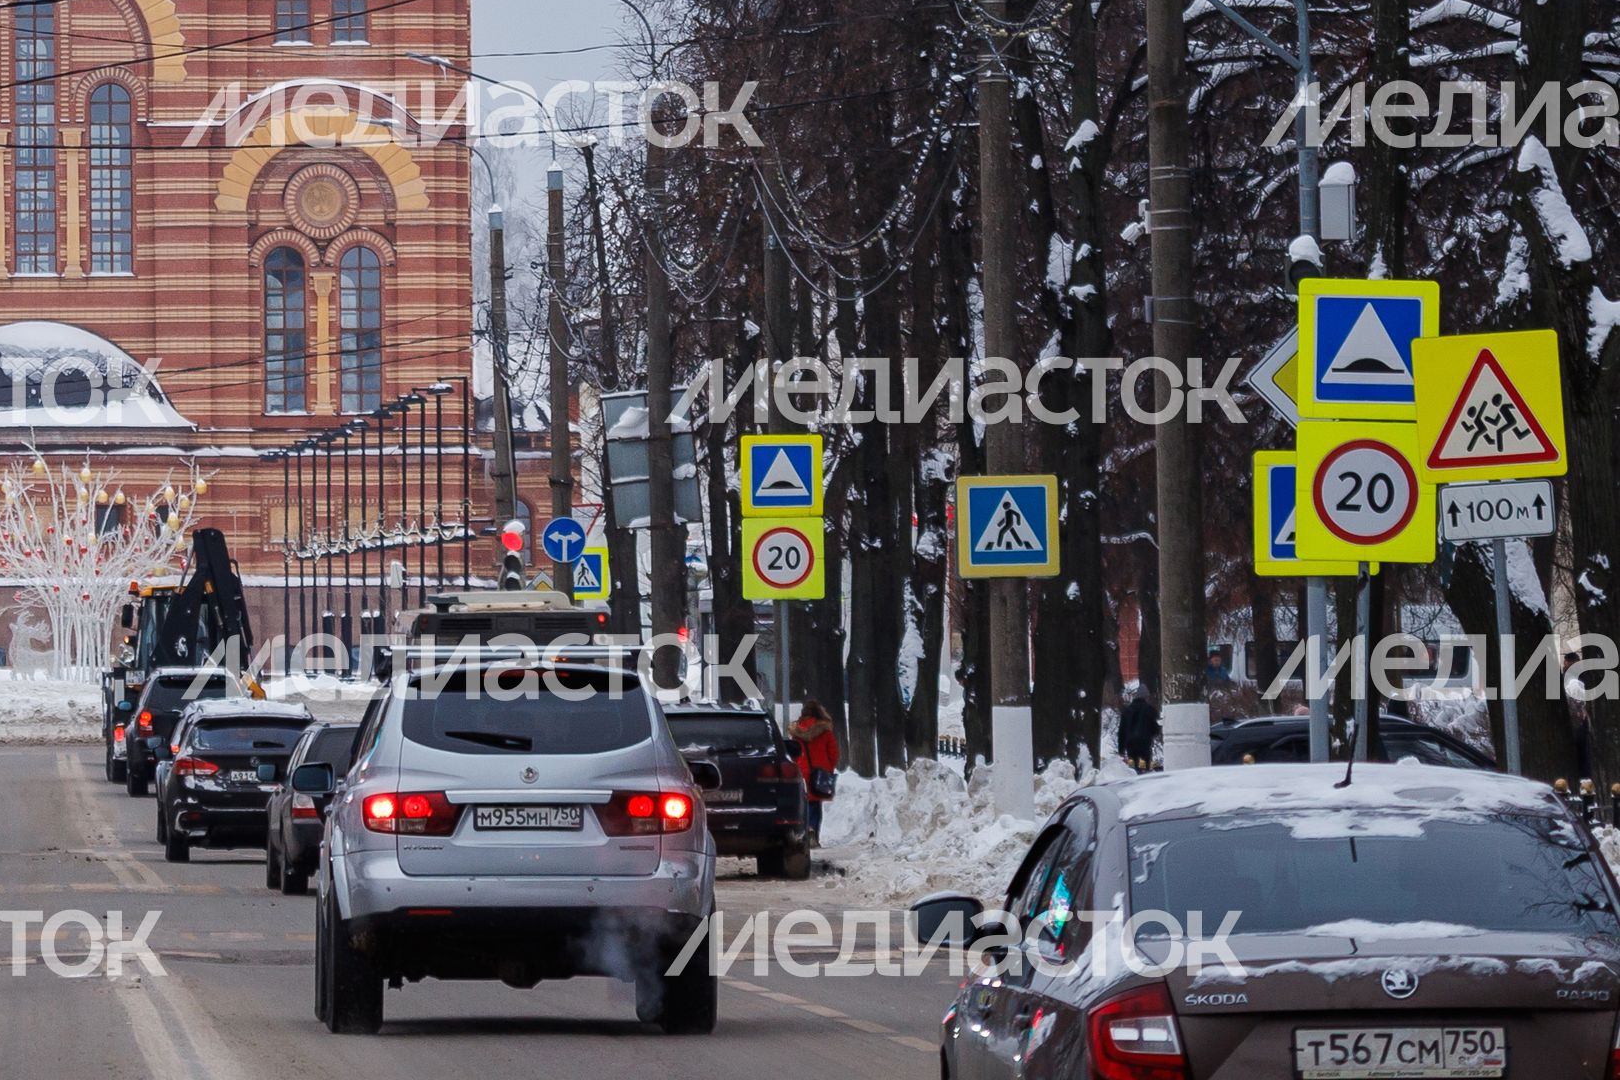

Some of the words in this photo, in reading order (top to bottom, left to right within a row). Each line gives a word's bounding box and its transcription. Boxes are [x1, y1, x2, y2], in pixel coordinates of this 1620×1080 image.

[1336, 471, 1395, 514] 20
[767, 546, 801, 571] 20
[553, 807, 577, 820] 750
[1307, 1032, 1440, 1067] Т567СМ
[1445, 1029, 1497, 1056] 750
